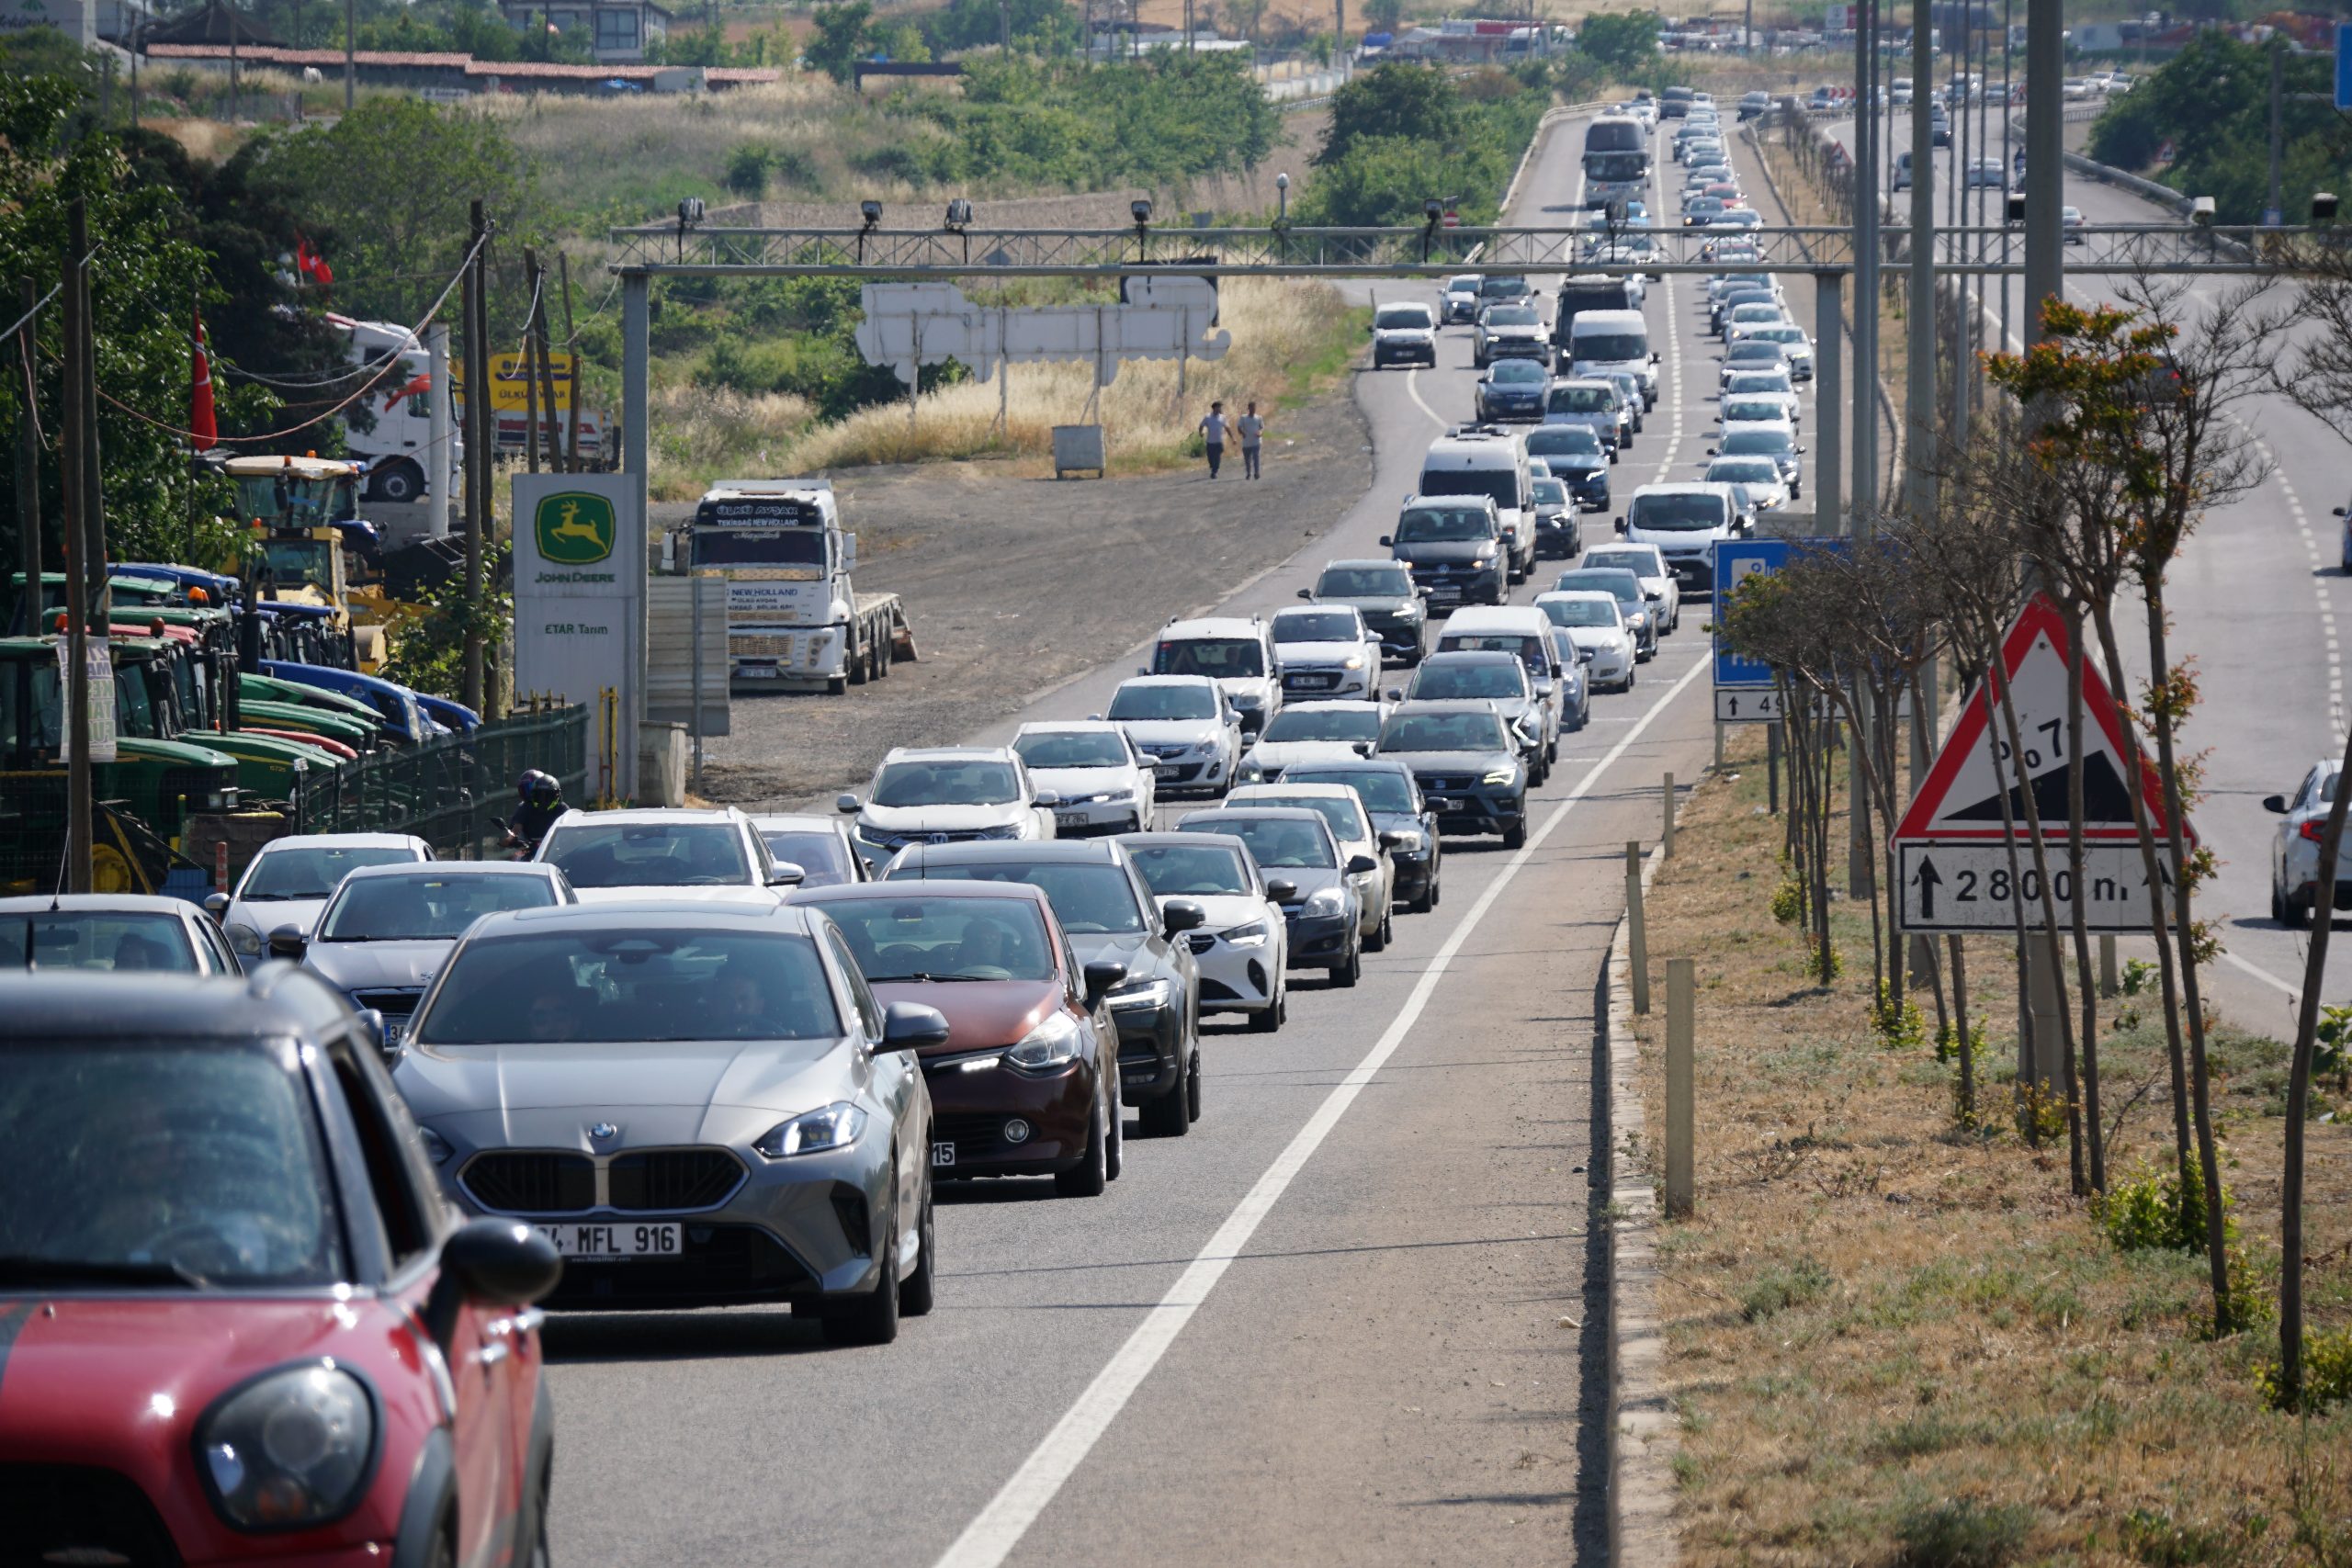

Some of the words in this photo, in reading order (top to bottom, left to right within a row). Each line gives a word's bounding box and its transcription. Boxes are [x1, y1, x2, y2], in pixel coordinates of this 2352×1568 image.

[535, 571, 570, 583] JOHN
[572, 572, 616, 582] DEERE
[545, 625, 574, 634] ETAR
[1956, 870, 2072, 901] 2800
[577, 1227, 621, 1253] MFL
[635, 1226, 675, 1252] 916
